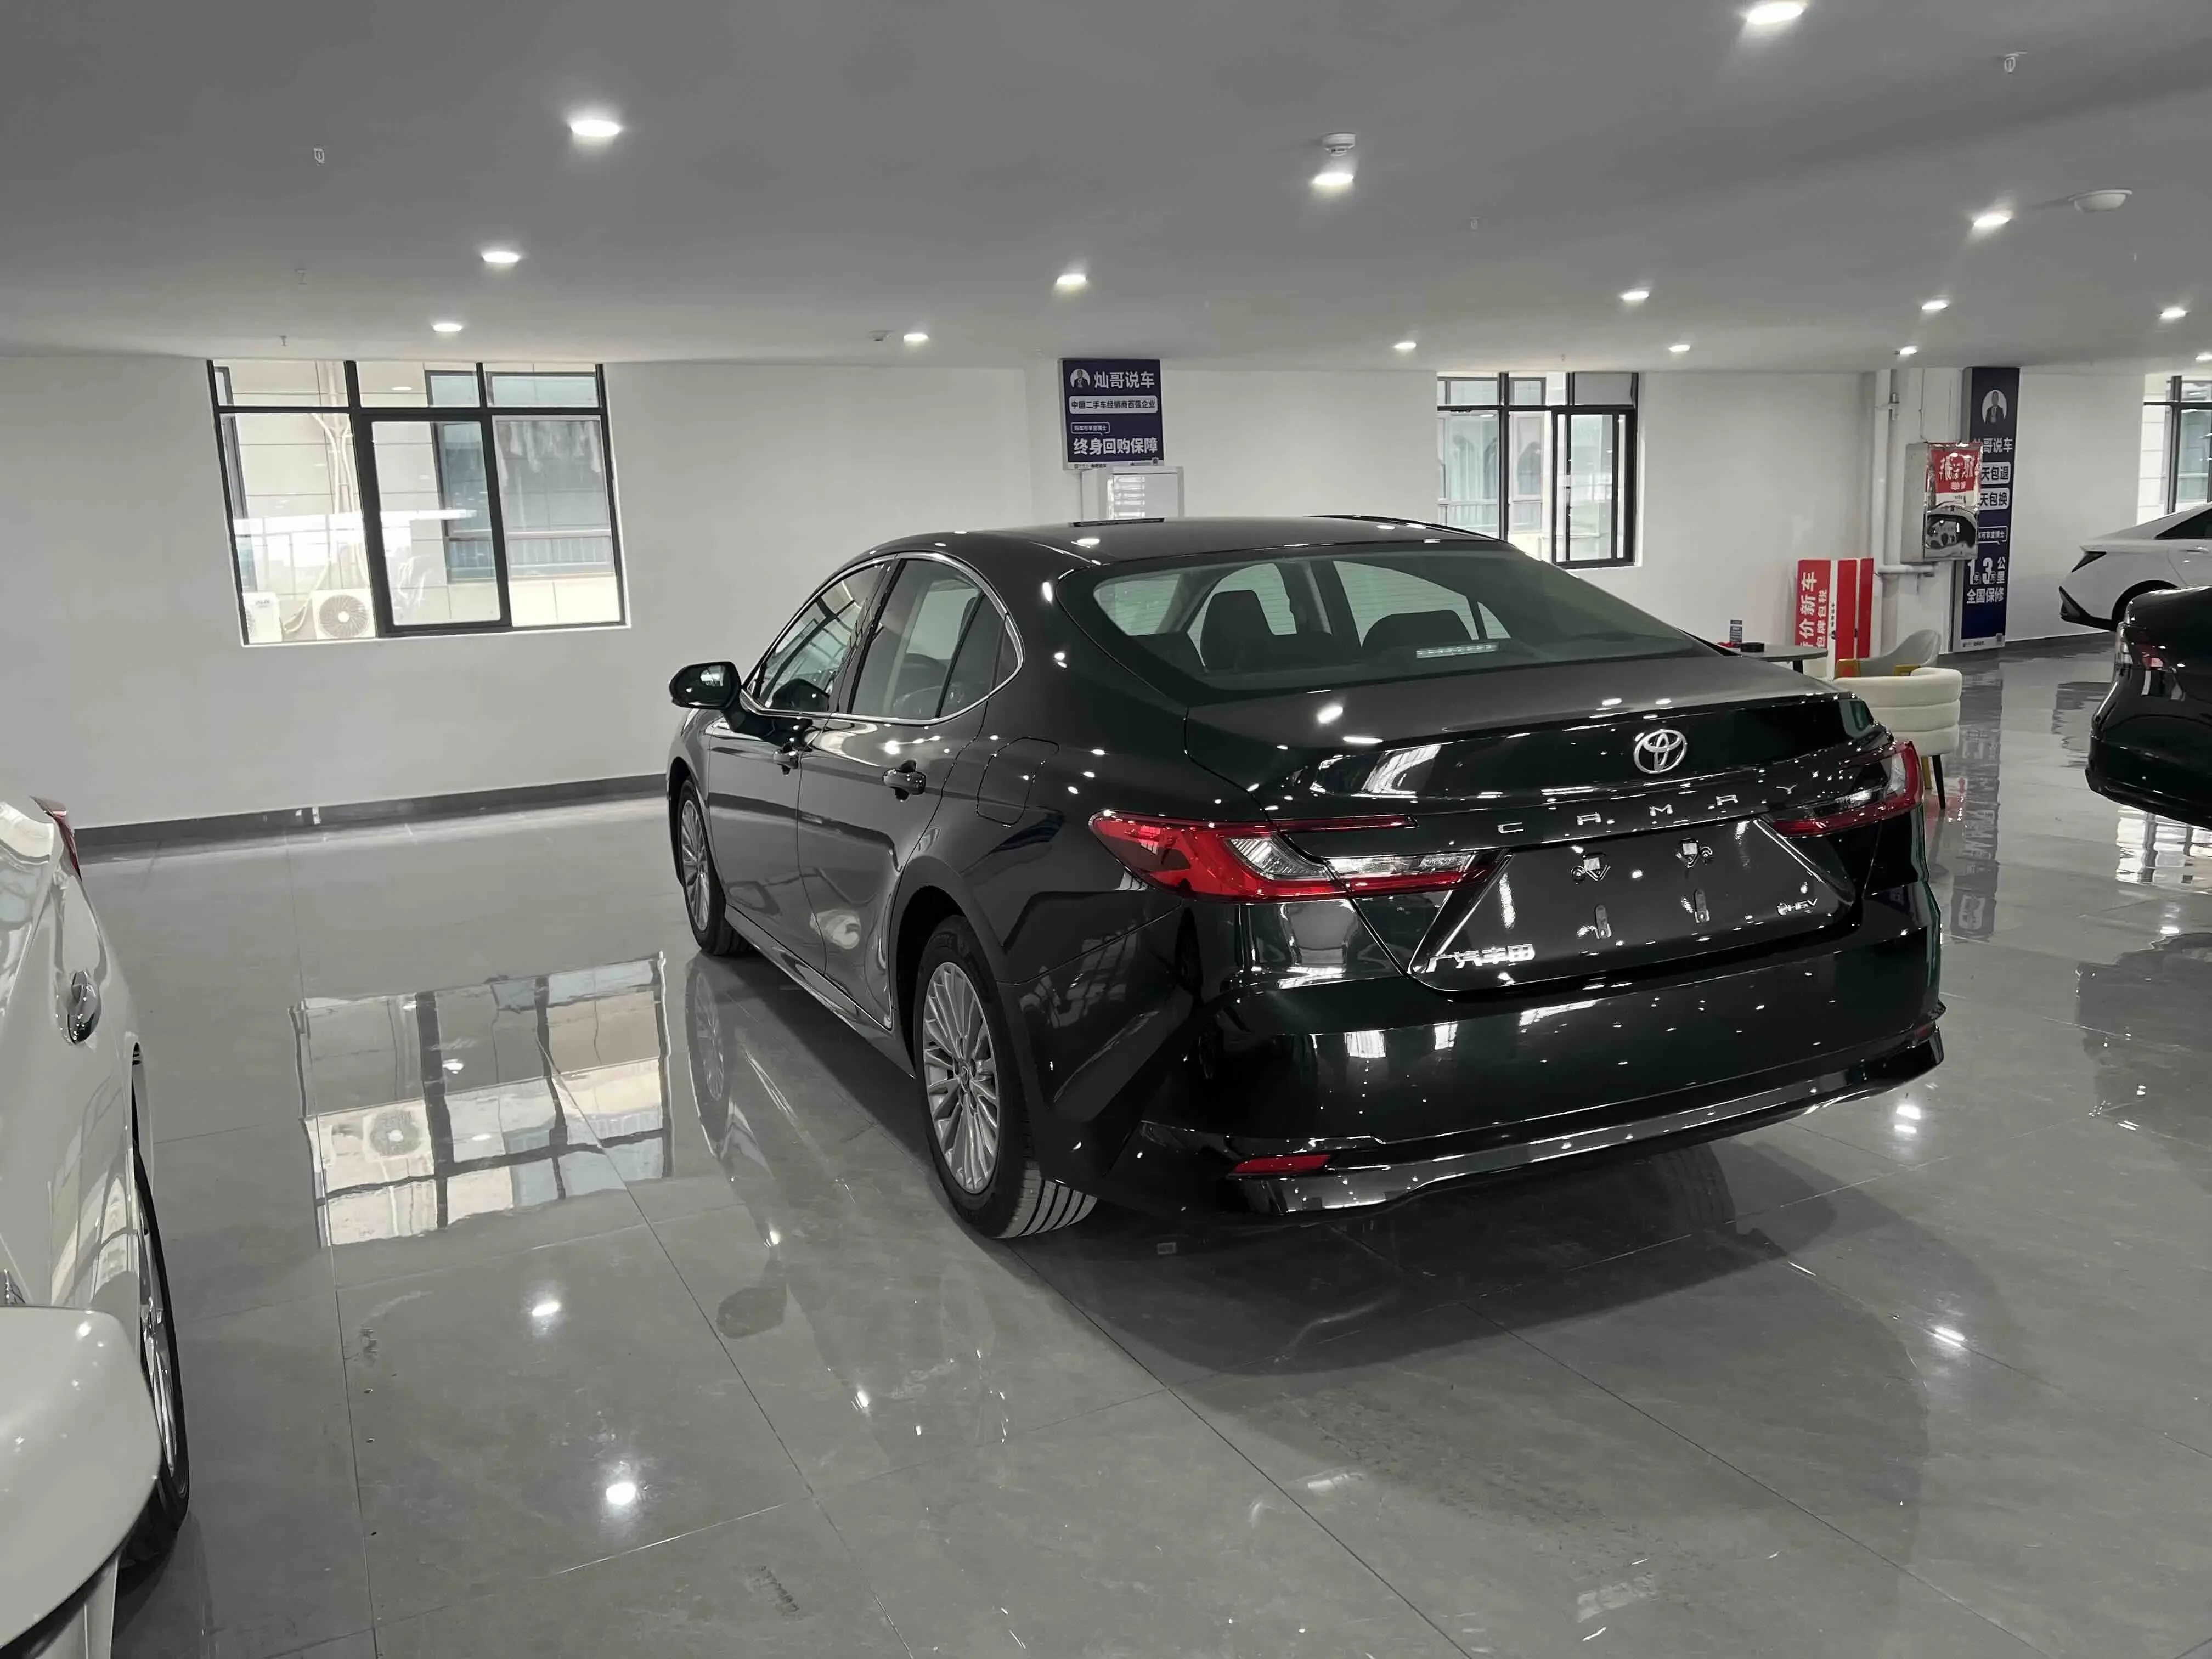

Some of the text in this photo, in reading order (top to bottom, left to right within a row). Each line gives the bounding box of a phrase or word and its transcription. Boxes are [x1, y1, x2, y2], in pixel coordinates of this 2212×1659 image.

[1094, 371, 1155, 389] 灿哥说车
[1074, 437, 1158, 455] 终身回购保障
[1973, 438, 2013, 453] 哥说车
[1966, 588, 2004, 604] 全国保修
[1498, 783, 1798, 833] CAMRY
